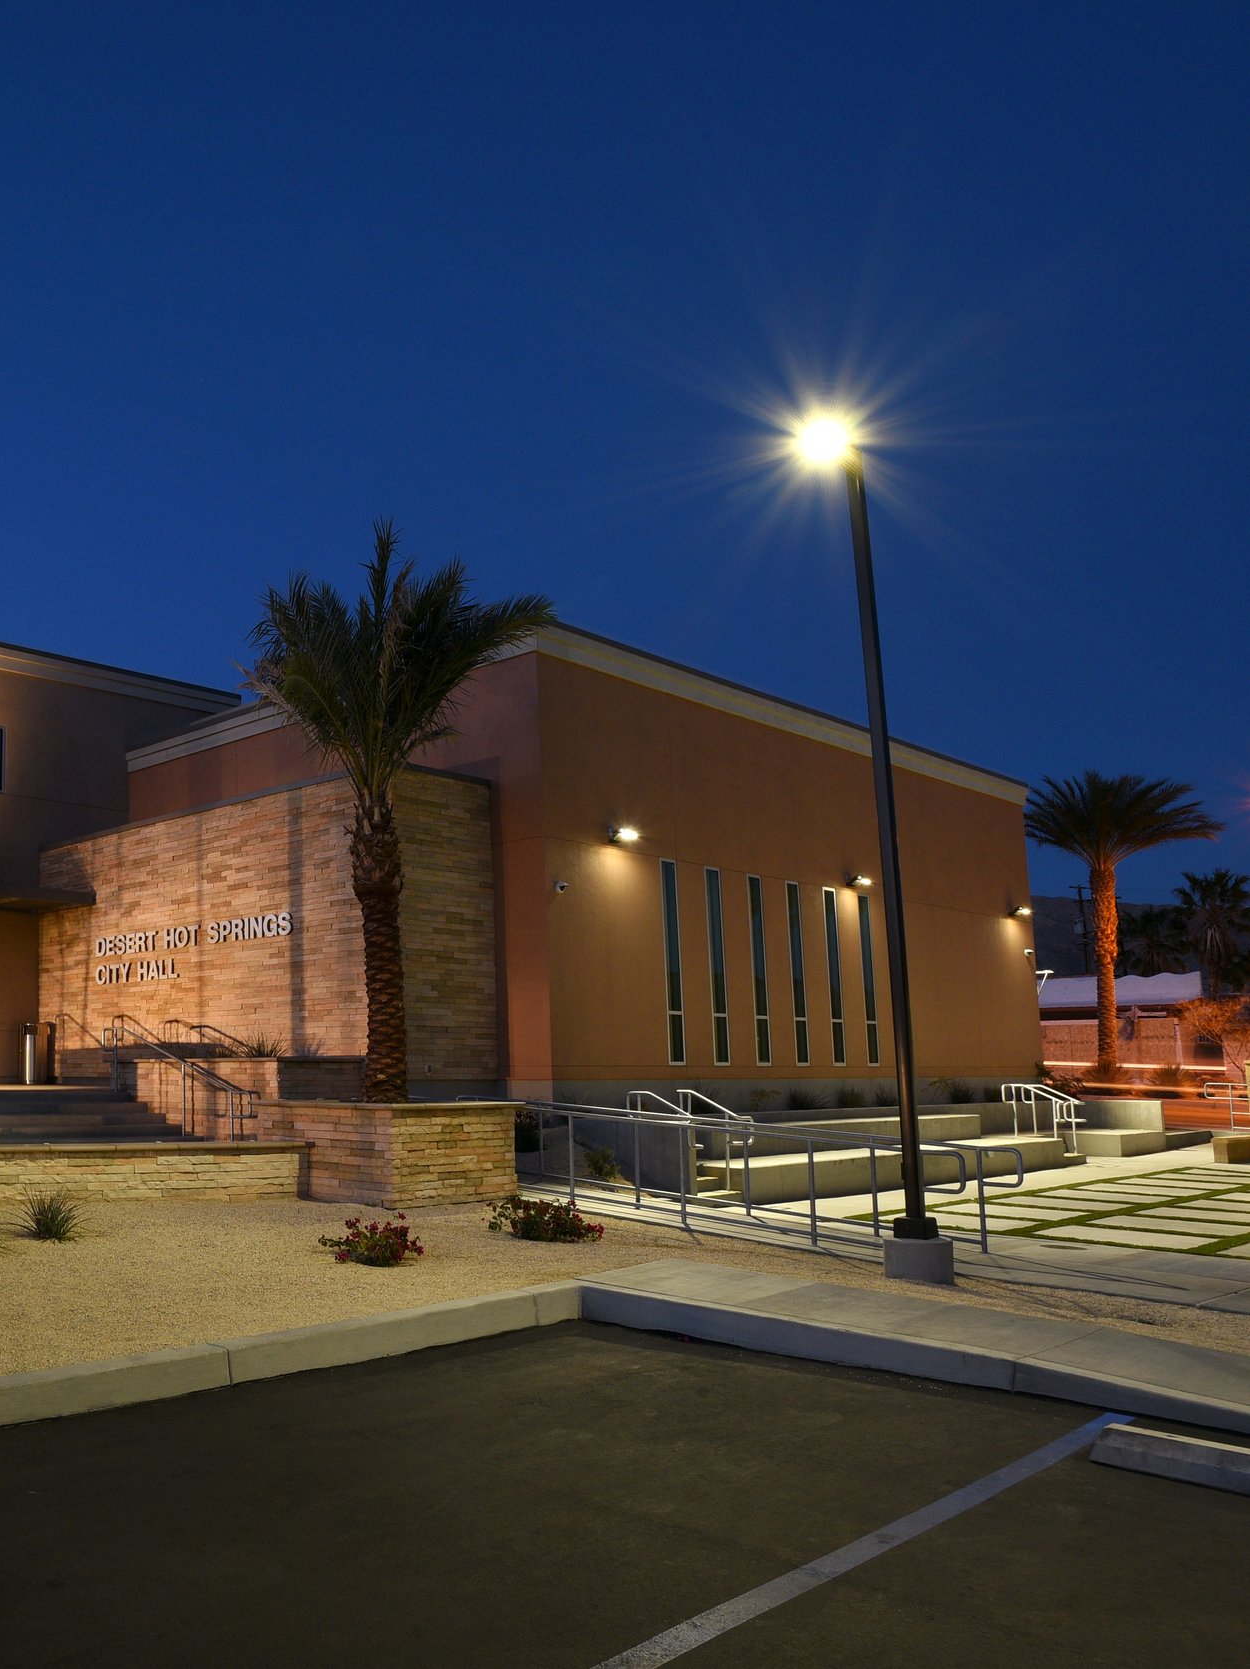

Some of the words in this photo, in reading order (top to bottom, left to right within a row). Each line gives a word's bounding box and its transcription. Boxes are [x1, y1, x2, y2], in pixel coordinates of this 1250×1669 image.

[95, 930, 158, 957] DESERT
[164, 925, 200, 949] HOT
[207, 912, 292, 944] SPRINGS
[95, 962, 132, 985] CITY
[137, 958, 179, 981] HALL
